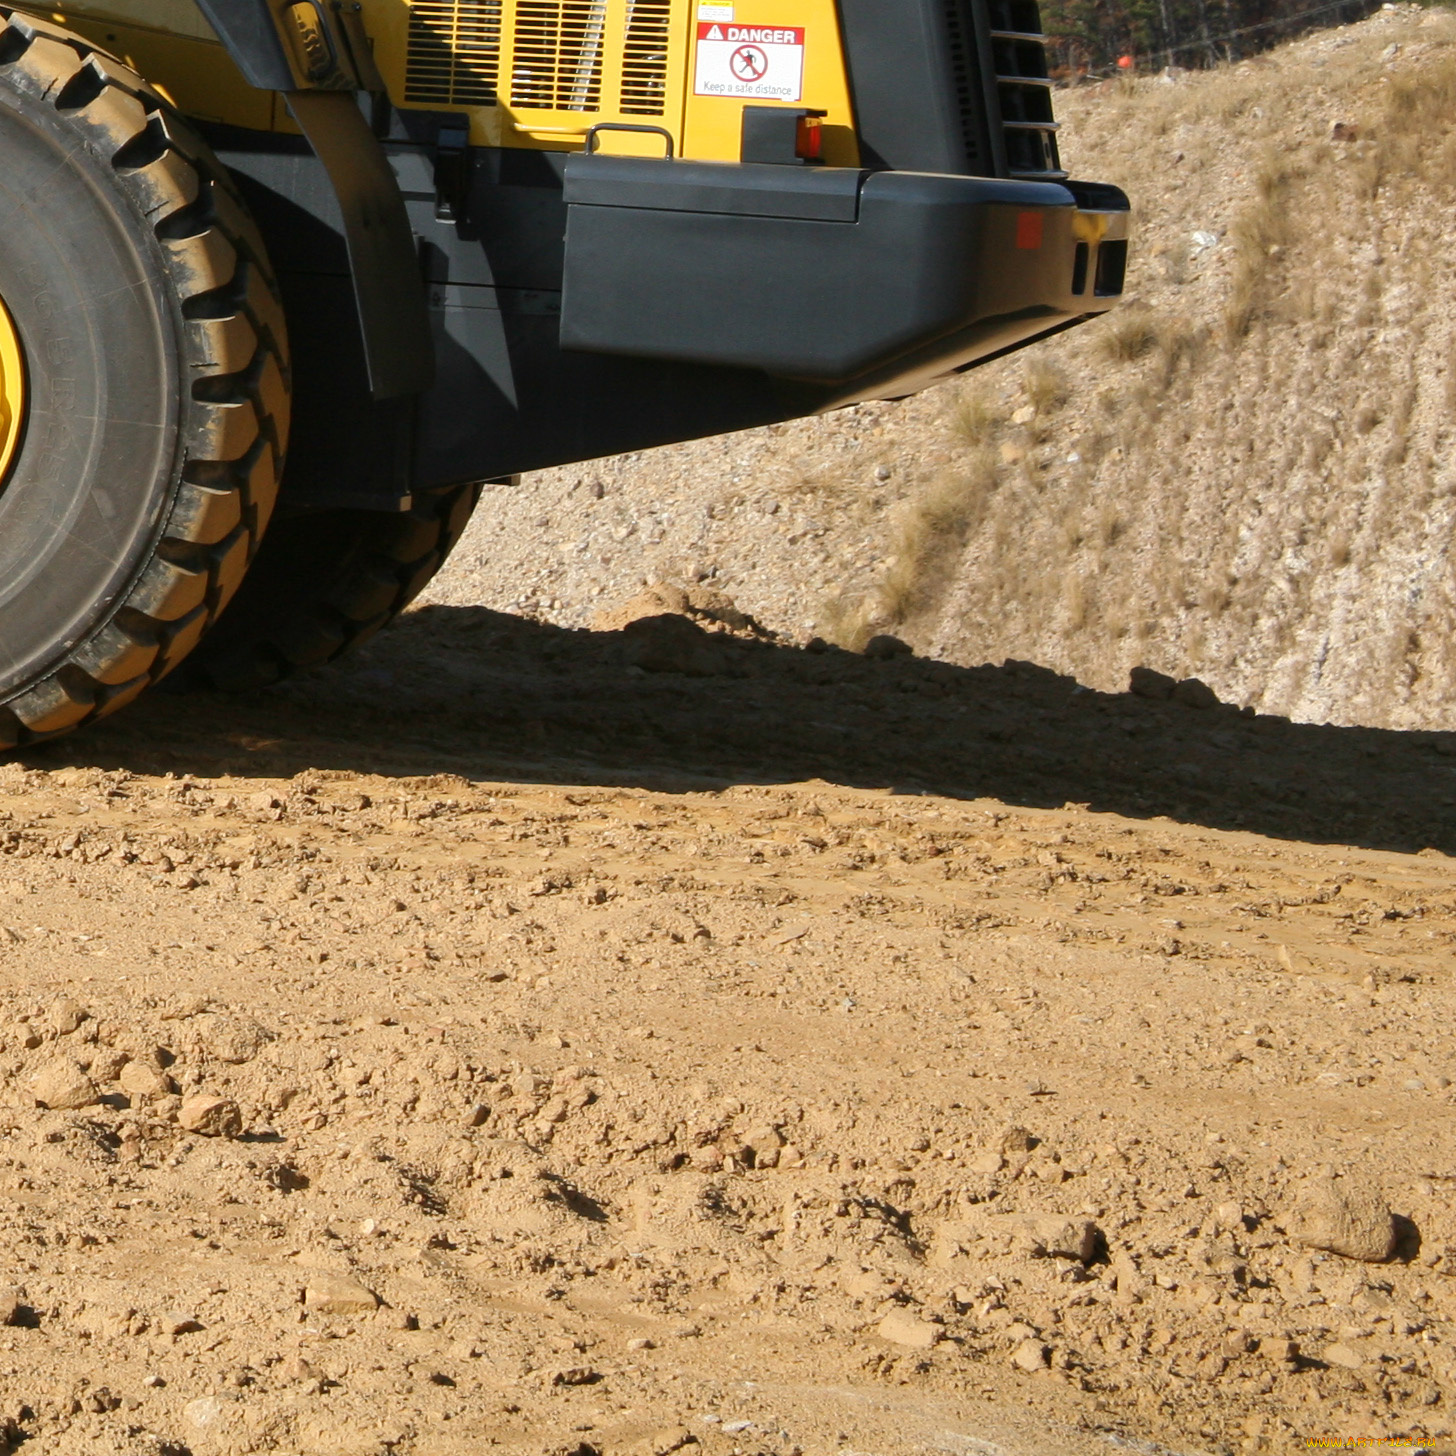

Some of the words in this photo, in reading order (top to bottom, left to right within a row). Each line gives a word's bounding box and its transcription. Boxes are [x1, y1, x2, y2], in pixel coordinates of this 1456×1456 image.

[728, 27, 795, 44] DANGER
[703, 81, 725, 94] Keep
[735, 83, 753, 93] safe
[755, 84, 792, 96] distance
